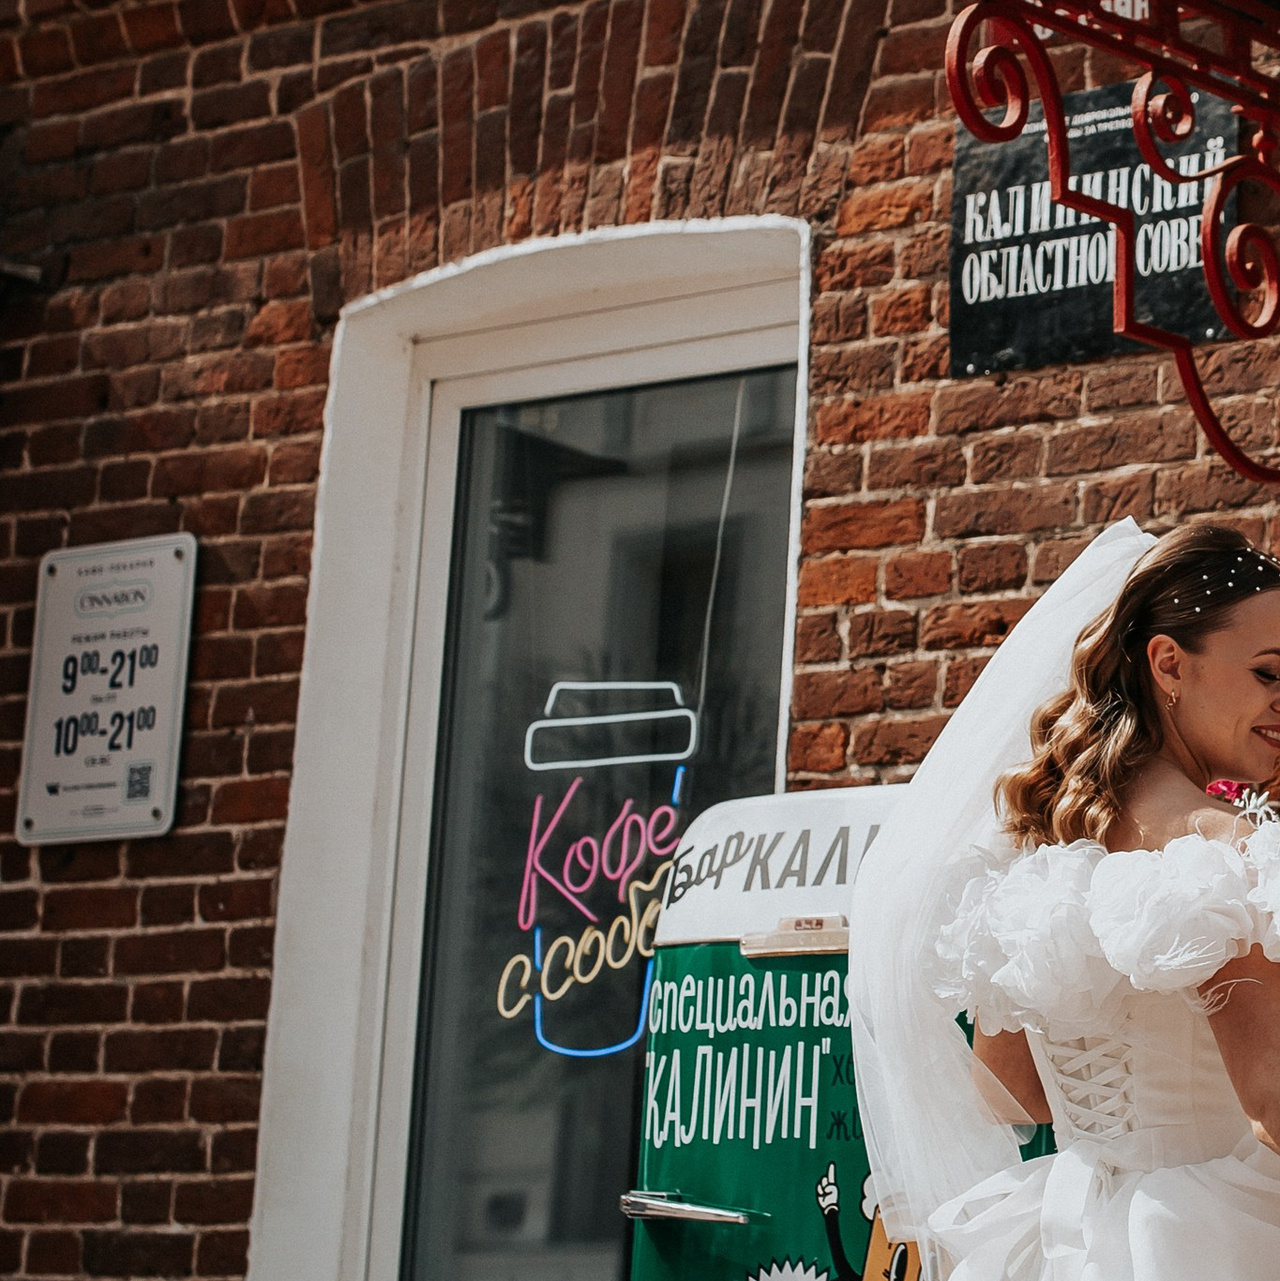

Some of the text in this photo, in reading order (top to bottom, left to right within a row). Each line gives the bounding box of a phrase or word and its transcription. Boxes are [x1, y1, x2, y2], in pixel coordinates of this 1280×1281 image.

[1135, 215, 1206, 277] СОВЕ
[518, 777, 680, 930] Кофе
[541, 860, 673, 1001] собо
